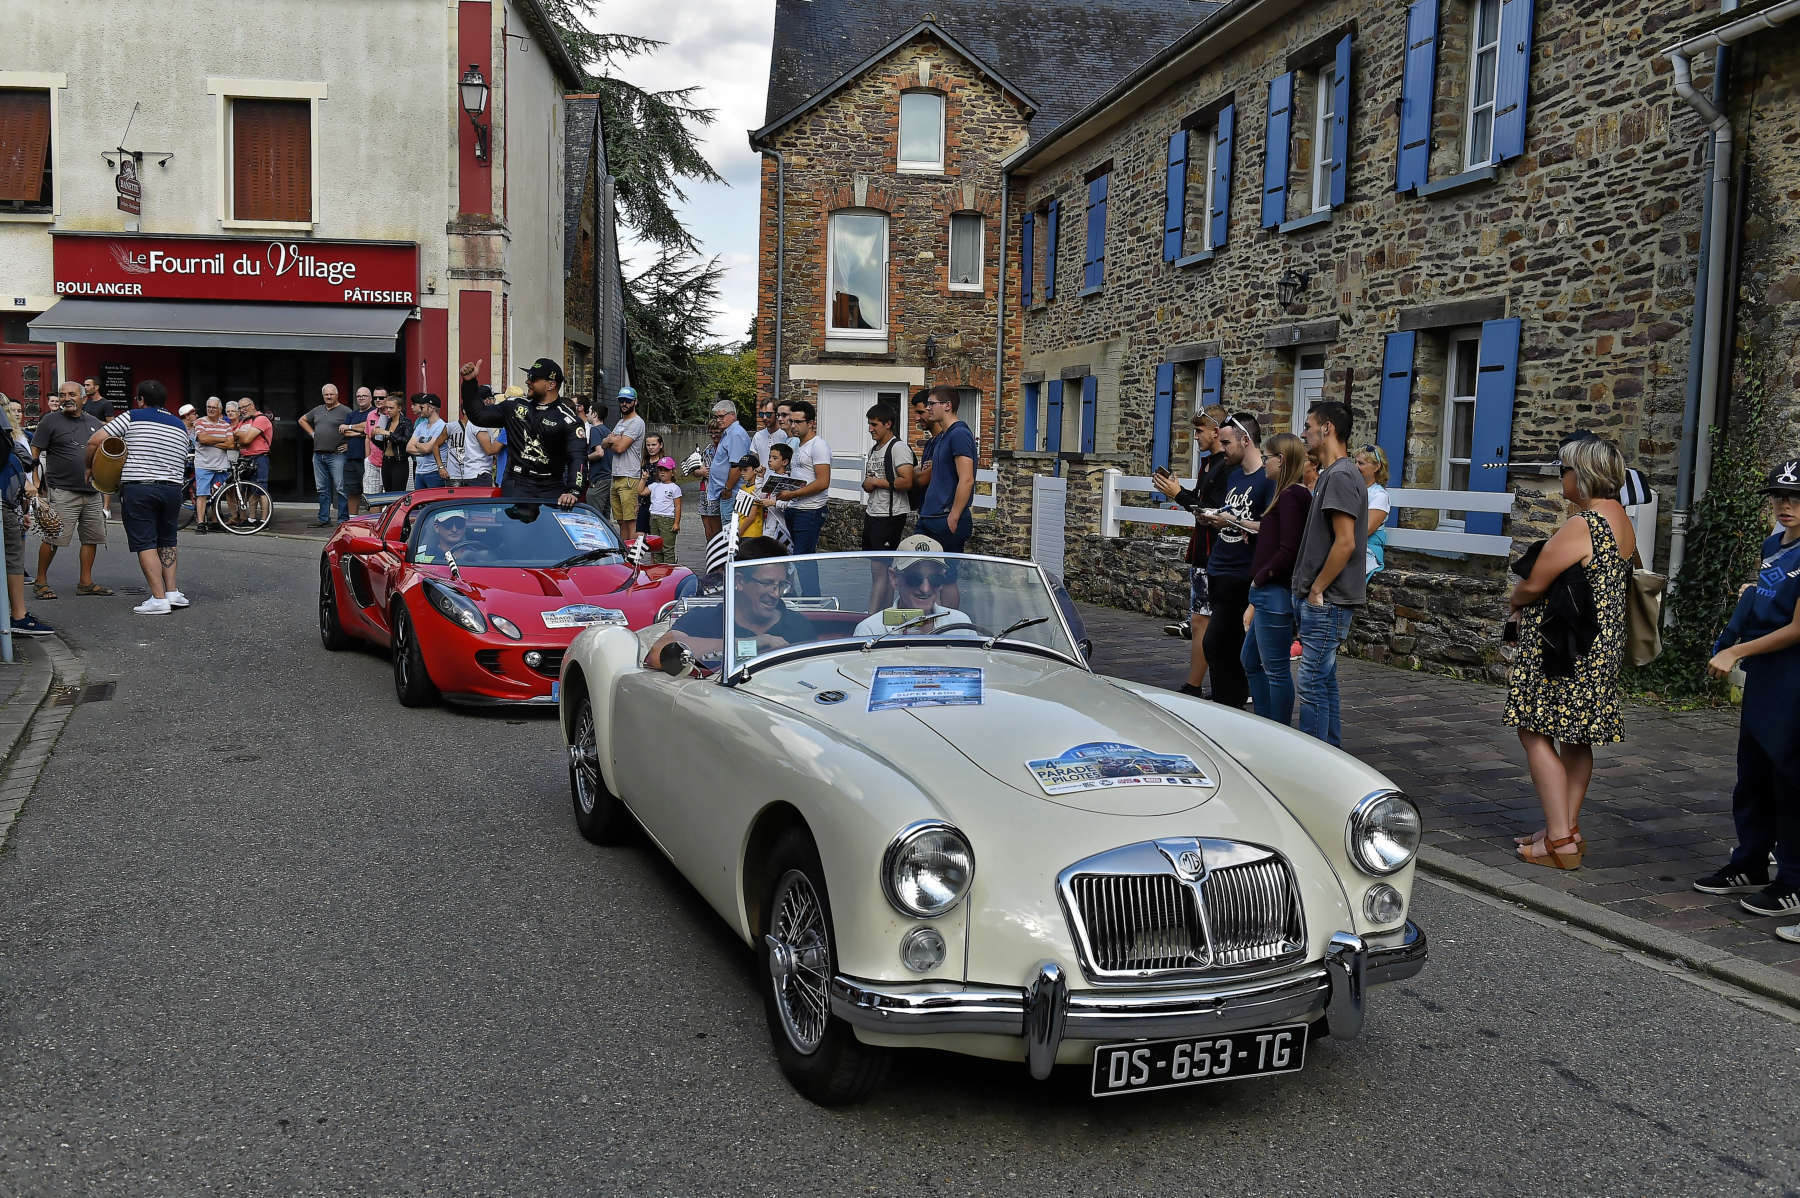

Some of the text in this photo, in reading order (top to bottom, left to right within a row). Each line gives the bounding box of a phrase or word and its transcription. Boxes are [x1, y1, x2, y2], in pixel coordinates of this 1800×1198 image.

[129, 242, 356, 285] Le Fournil du Village
[56, 281, 143, 295] BOULANGER
[344, 287, 413, 303] PÂTISSIER
[1037, 765, 1094, 778] PARADE
[1051, 771, 1101, 784] PILOTES
[1181, 853, 1201, 872] MG
